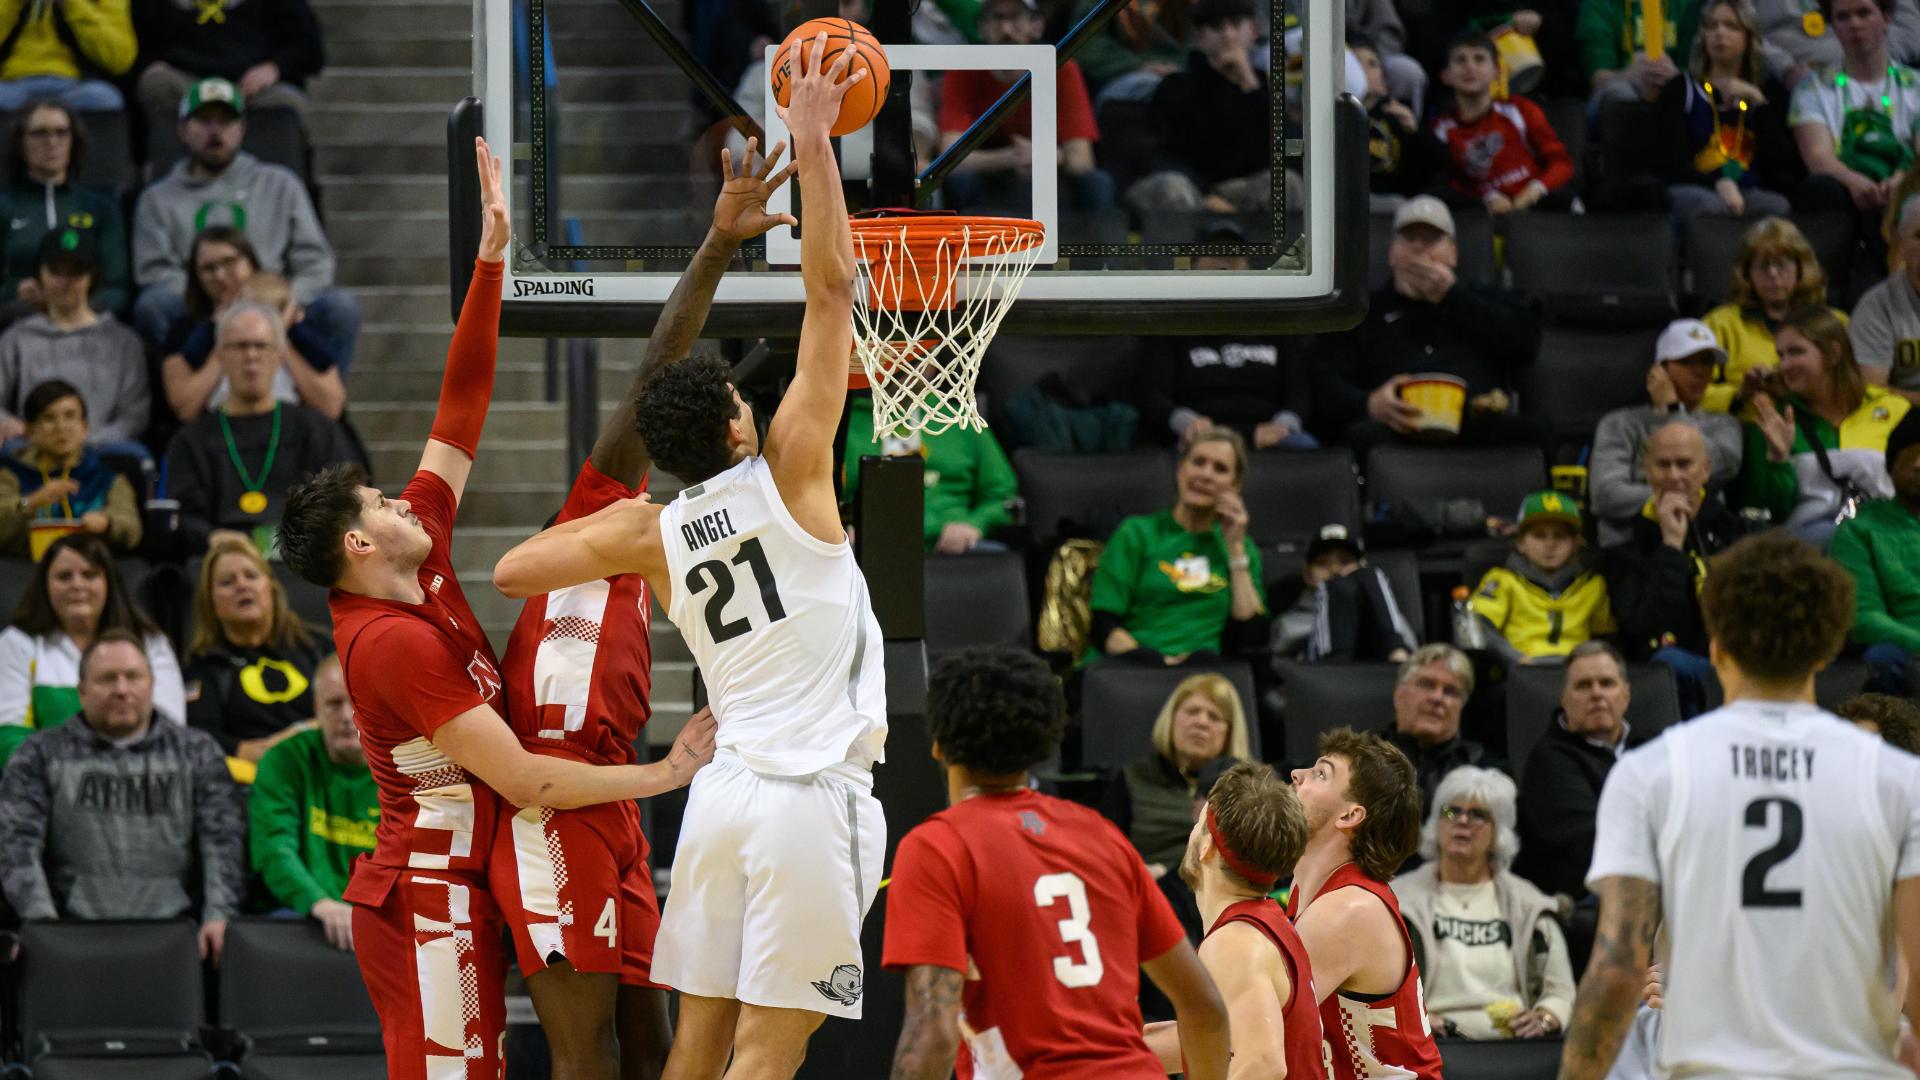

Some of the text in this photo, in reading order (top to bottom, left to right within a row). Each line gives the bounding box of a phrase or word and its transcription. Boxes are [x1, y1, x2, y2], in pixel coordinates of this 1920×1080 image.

[513, 278, 594, 297] SPALDING
[681, 508, 737, 551] ANGEL
[685, 536, 787, 644] 21
[1730, 745, 1816, 782] TRACEY
[73, 771, 178, 815] ARMY
[1741, 795, 1804, 909] 2
[594, 898, 618, 948] 4
[1034, 872, 1104, 988] 3
